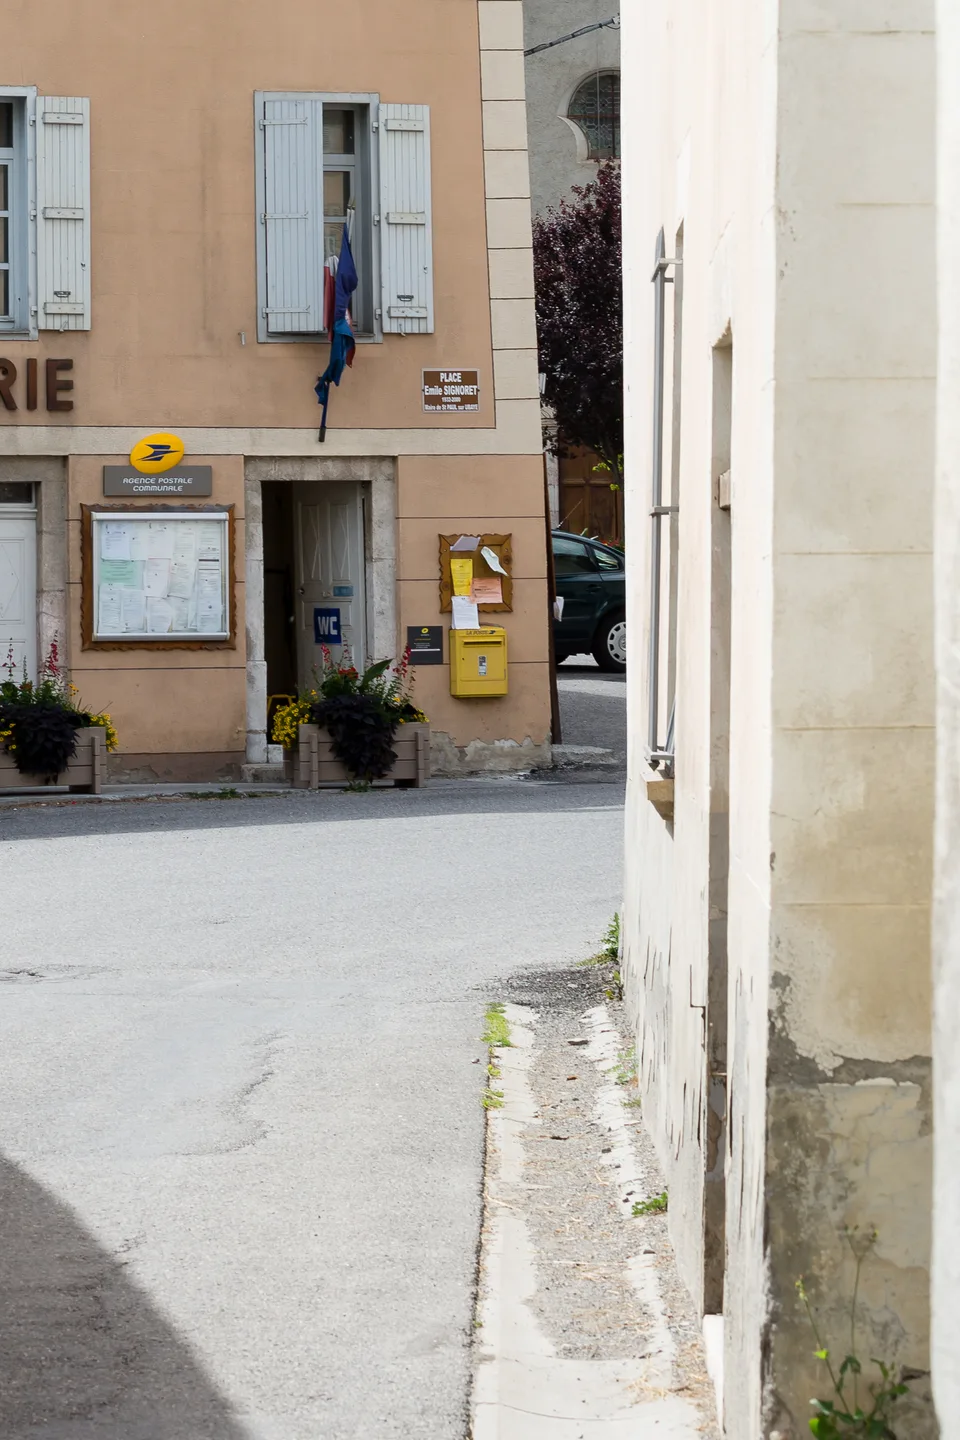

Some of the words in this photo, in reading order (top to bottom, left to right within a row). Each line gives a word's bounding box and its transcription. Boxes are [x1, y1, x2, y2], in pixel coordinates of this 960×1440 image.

[440, 372, 462, 383] PLACE
[424, 385, 442, 395] Emile
[443, 385, 477, 395] SIGNORET
[317, 616, 338, 635] WC
